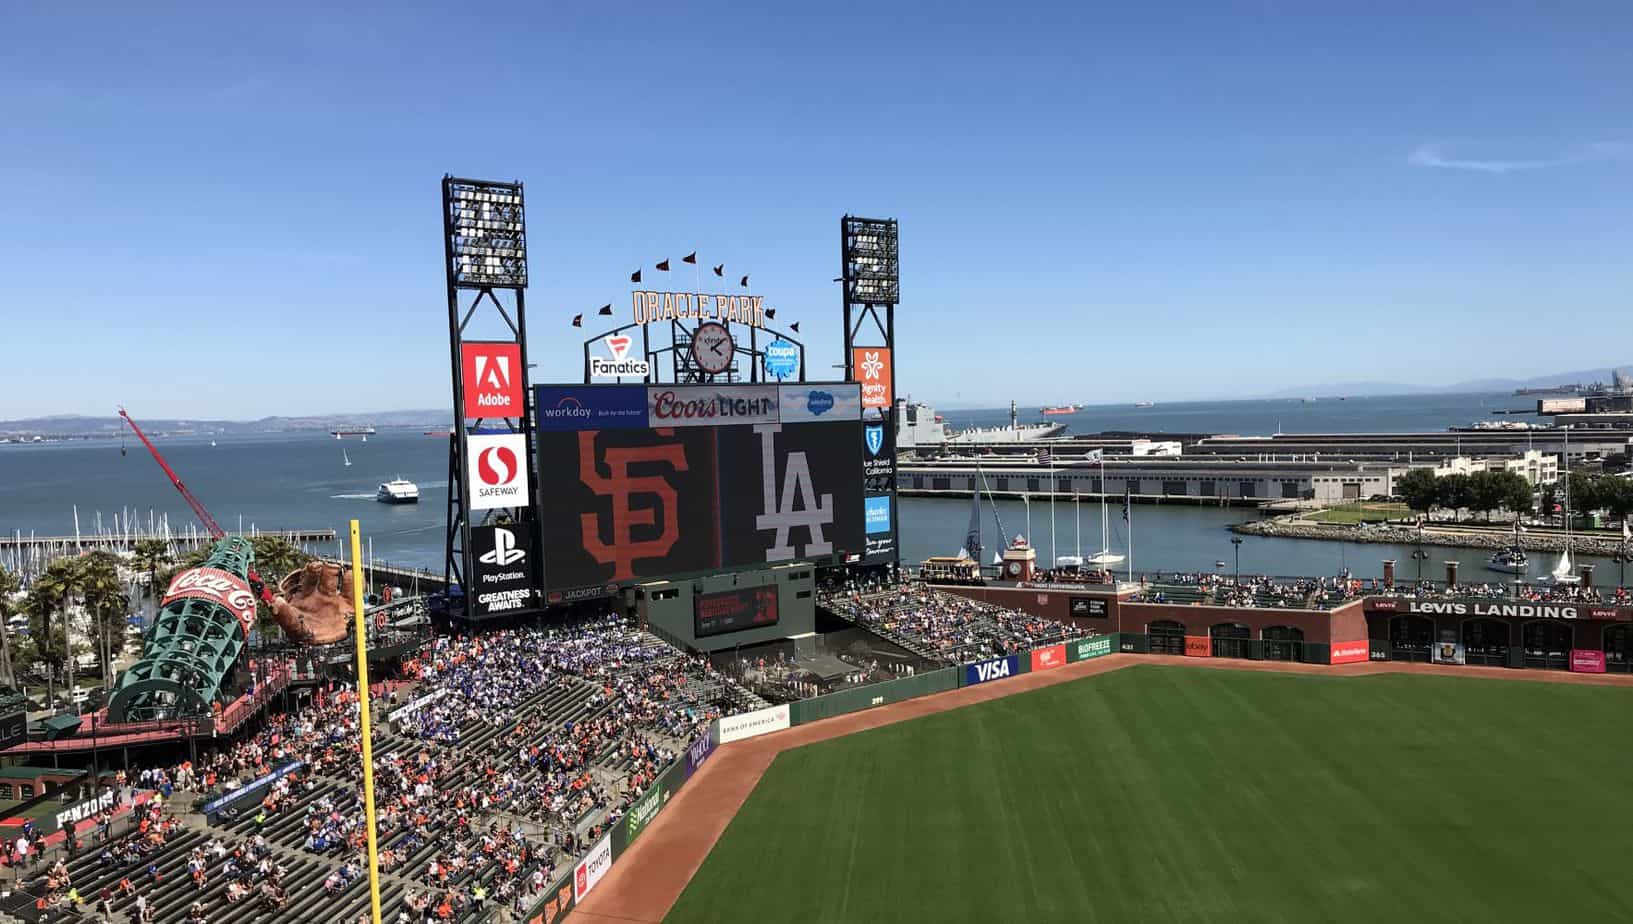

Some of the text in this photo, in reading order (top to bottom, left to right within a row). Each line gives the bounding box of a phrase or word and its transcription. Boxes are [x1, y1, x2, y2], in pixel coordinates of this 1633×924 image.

[632, 291, 765, 329] ORACLE PARK
[592, 359, 648, 374] Fanatics
[477, 392, 511, 406] Adobe
[654, 391, 769, 419] Coors LIGHT
[545, 406, 591, 419] workday
[479, 486, 519, 498] SAFEWAY
[753, 424, 834, 562] LA
[482, 570, 525, 583] PlayStation
[478, 588, 530, 604] GREATNESS
[565, 587, 602, 600] JACKPOT
[1474, 604, 1577, 619] LANDING
[1078, 639, 1111, 654] BIOFREEZE
[975, 659, 1010, 682] VISA
[749, 717, 775, 728] AMERICA
[588, 847, 610, 876] TOYOTA
